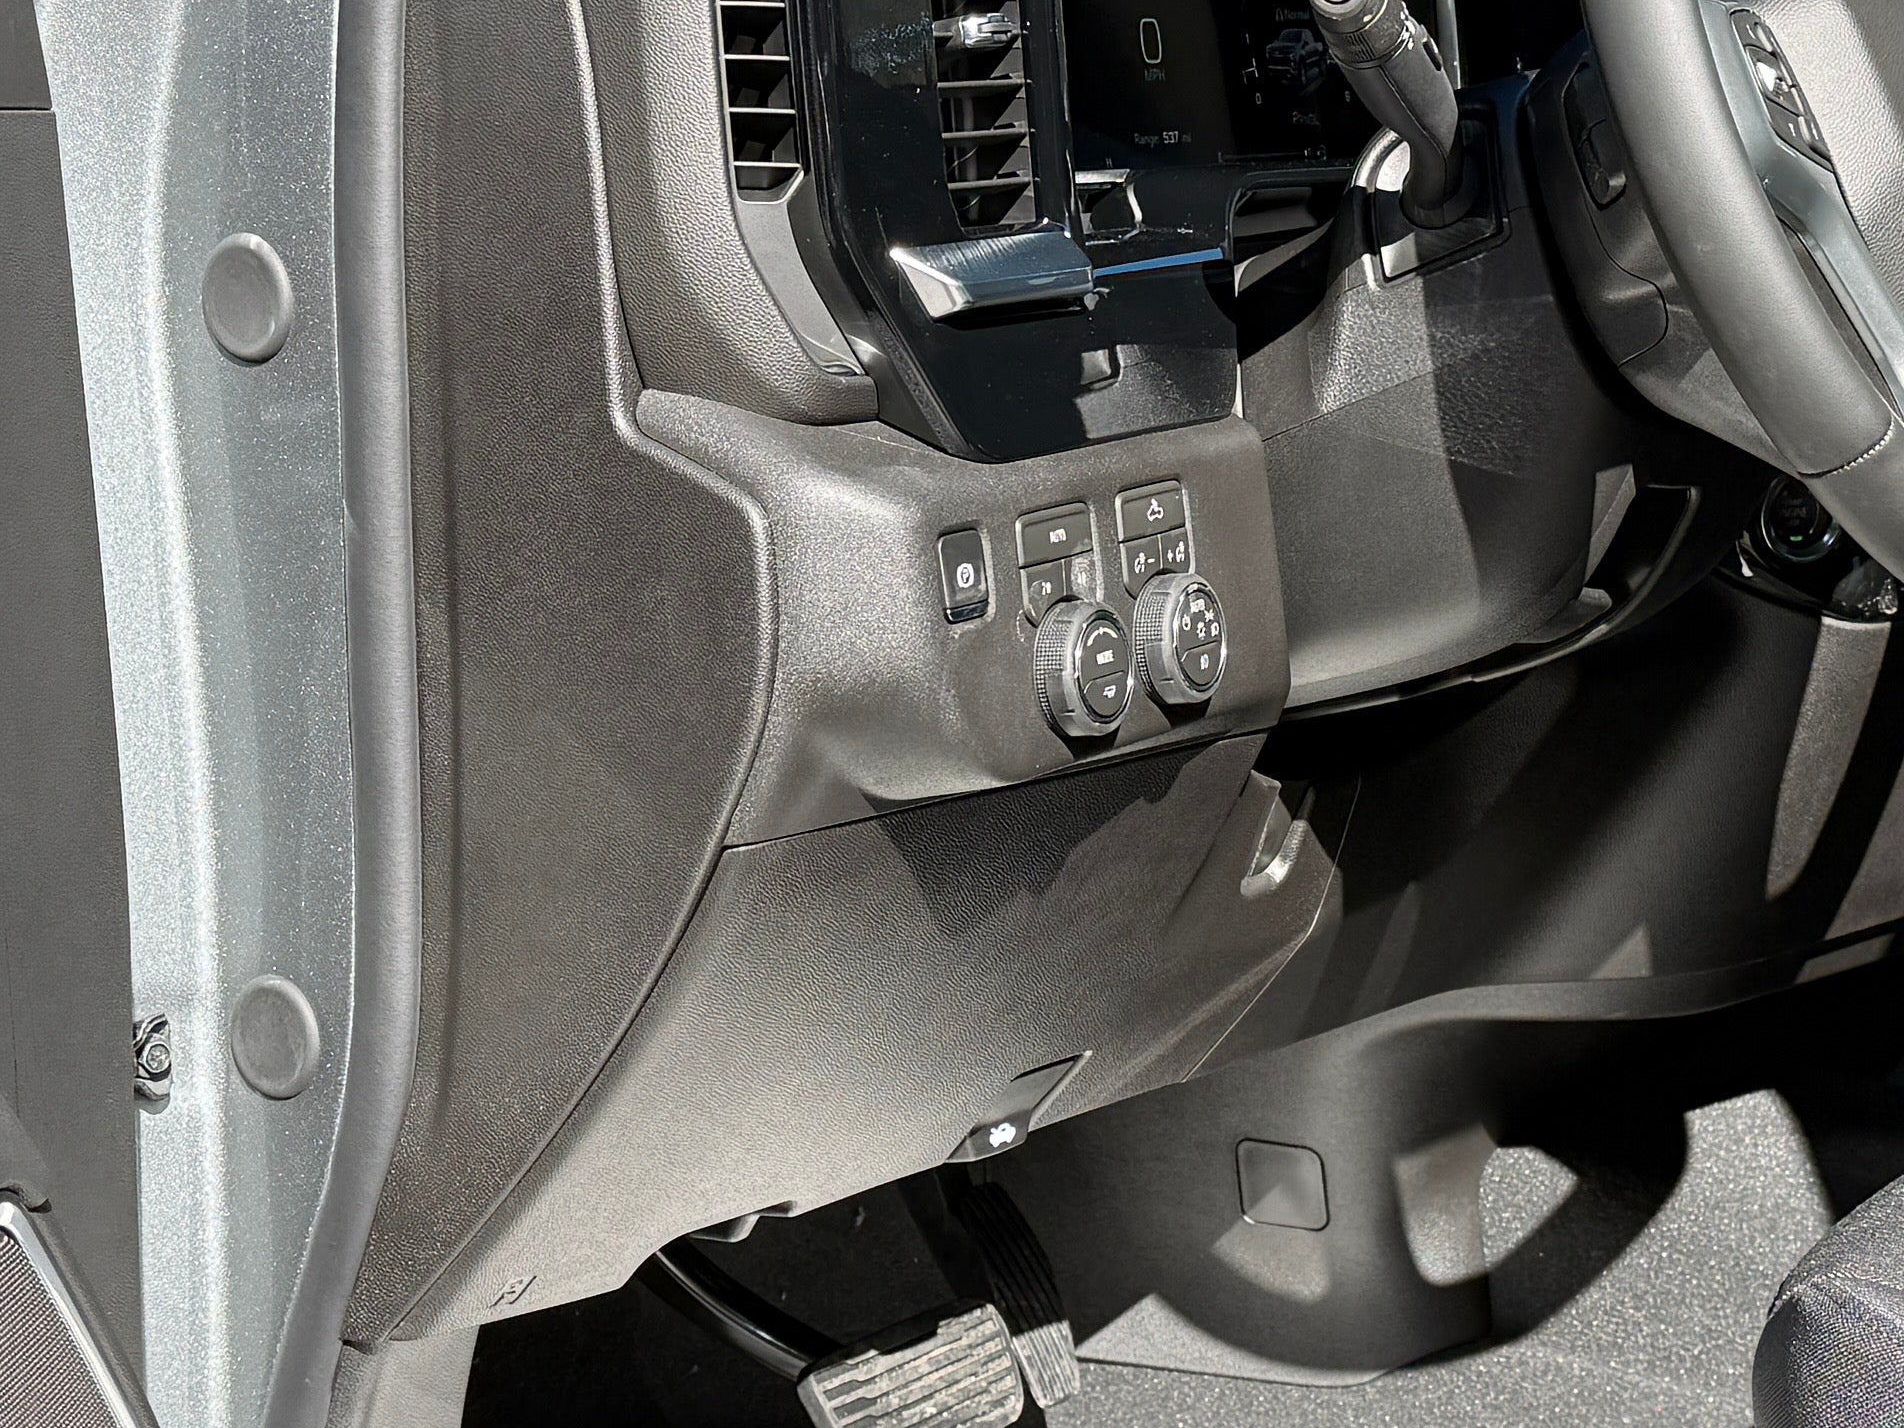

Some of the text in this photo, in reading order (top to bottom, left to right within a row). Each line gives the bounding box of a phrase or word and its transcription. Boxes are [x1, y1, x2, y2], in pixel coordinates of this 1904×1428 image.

[1139, 17, 1163, 65] 0
[1144, 69, 1166, 82] MPH
[1162, 131, 1180, 145] 537
